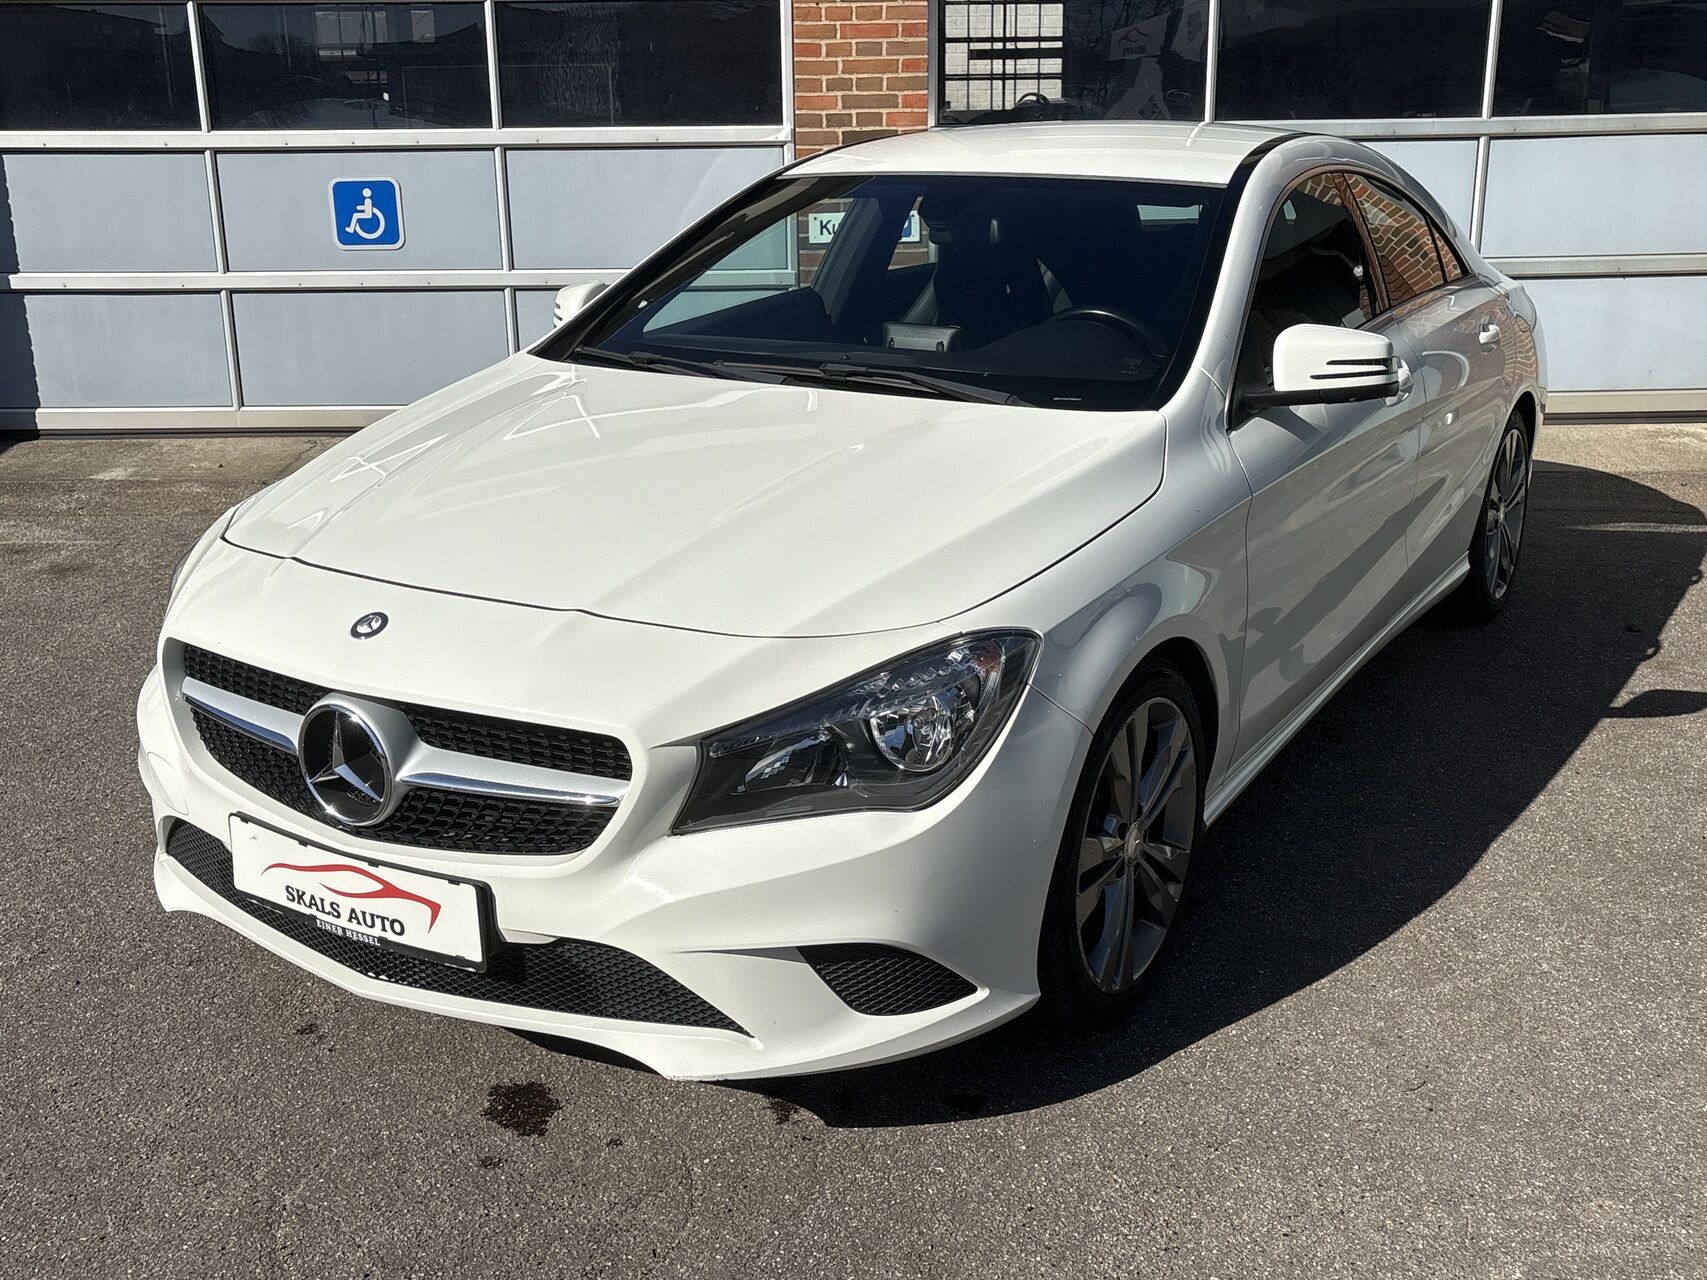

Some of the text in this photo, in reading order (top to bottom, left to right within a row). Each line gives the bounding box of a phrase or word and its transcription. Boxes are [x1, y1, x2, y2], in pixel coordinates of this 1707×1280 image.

[285, 885, 405, 936] SKALS AUTO
[316, 919, 381, 946] EJNER HESSEL
